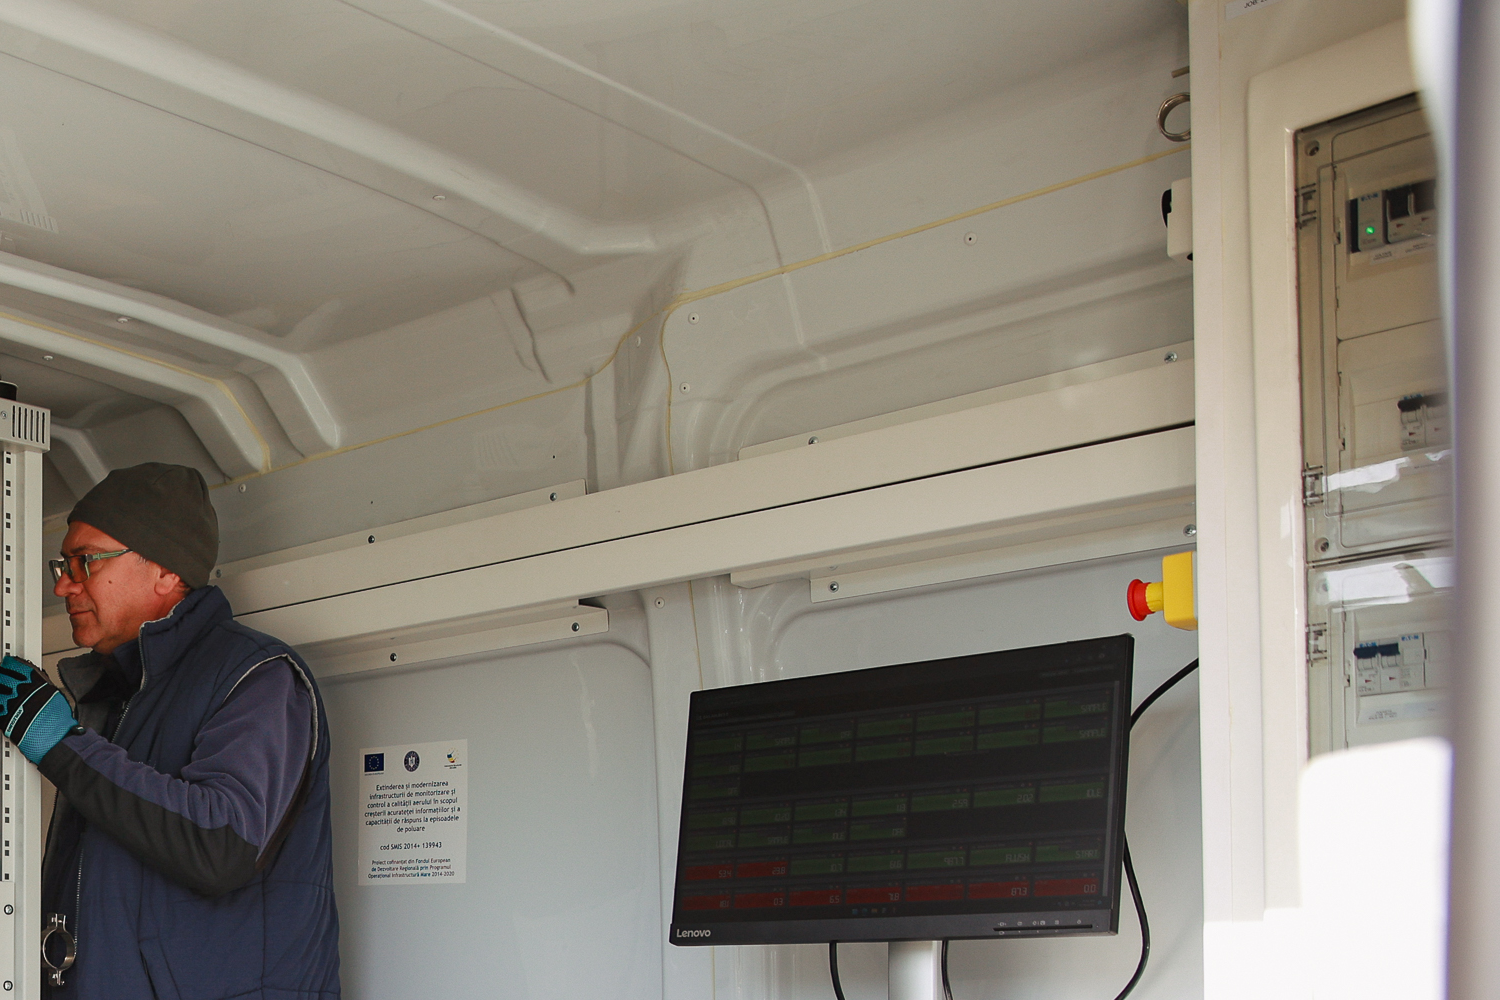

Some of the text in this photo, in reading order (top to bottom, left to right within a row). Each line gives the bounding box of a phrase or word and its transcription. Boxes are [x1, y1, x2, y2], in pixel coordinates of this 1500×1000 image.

[369, 792, 405, 800] infrastructurii
[414, 789, 450, 797] monitorizare
[429, 815, 459, 823] episoadele
[677, 929, 711, 937] Lenovo
